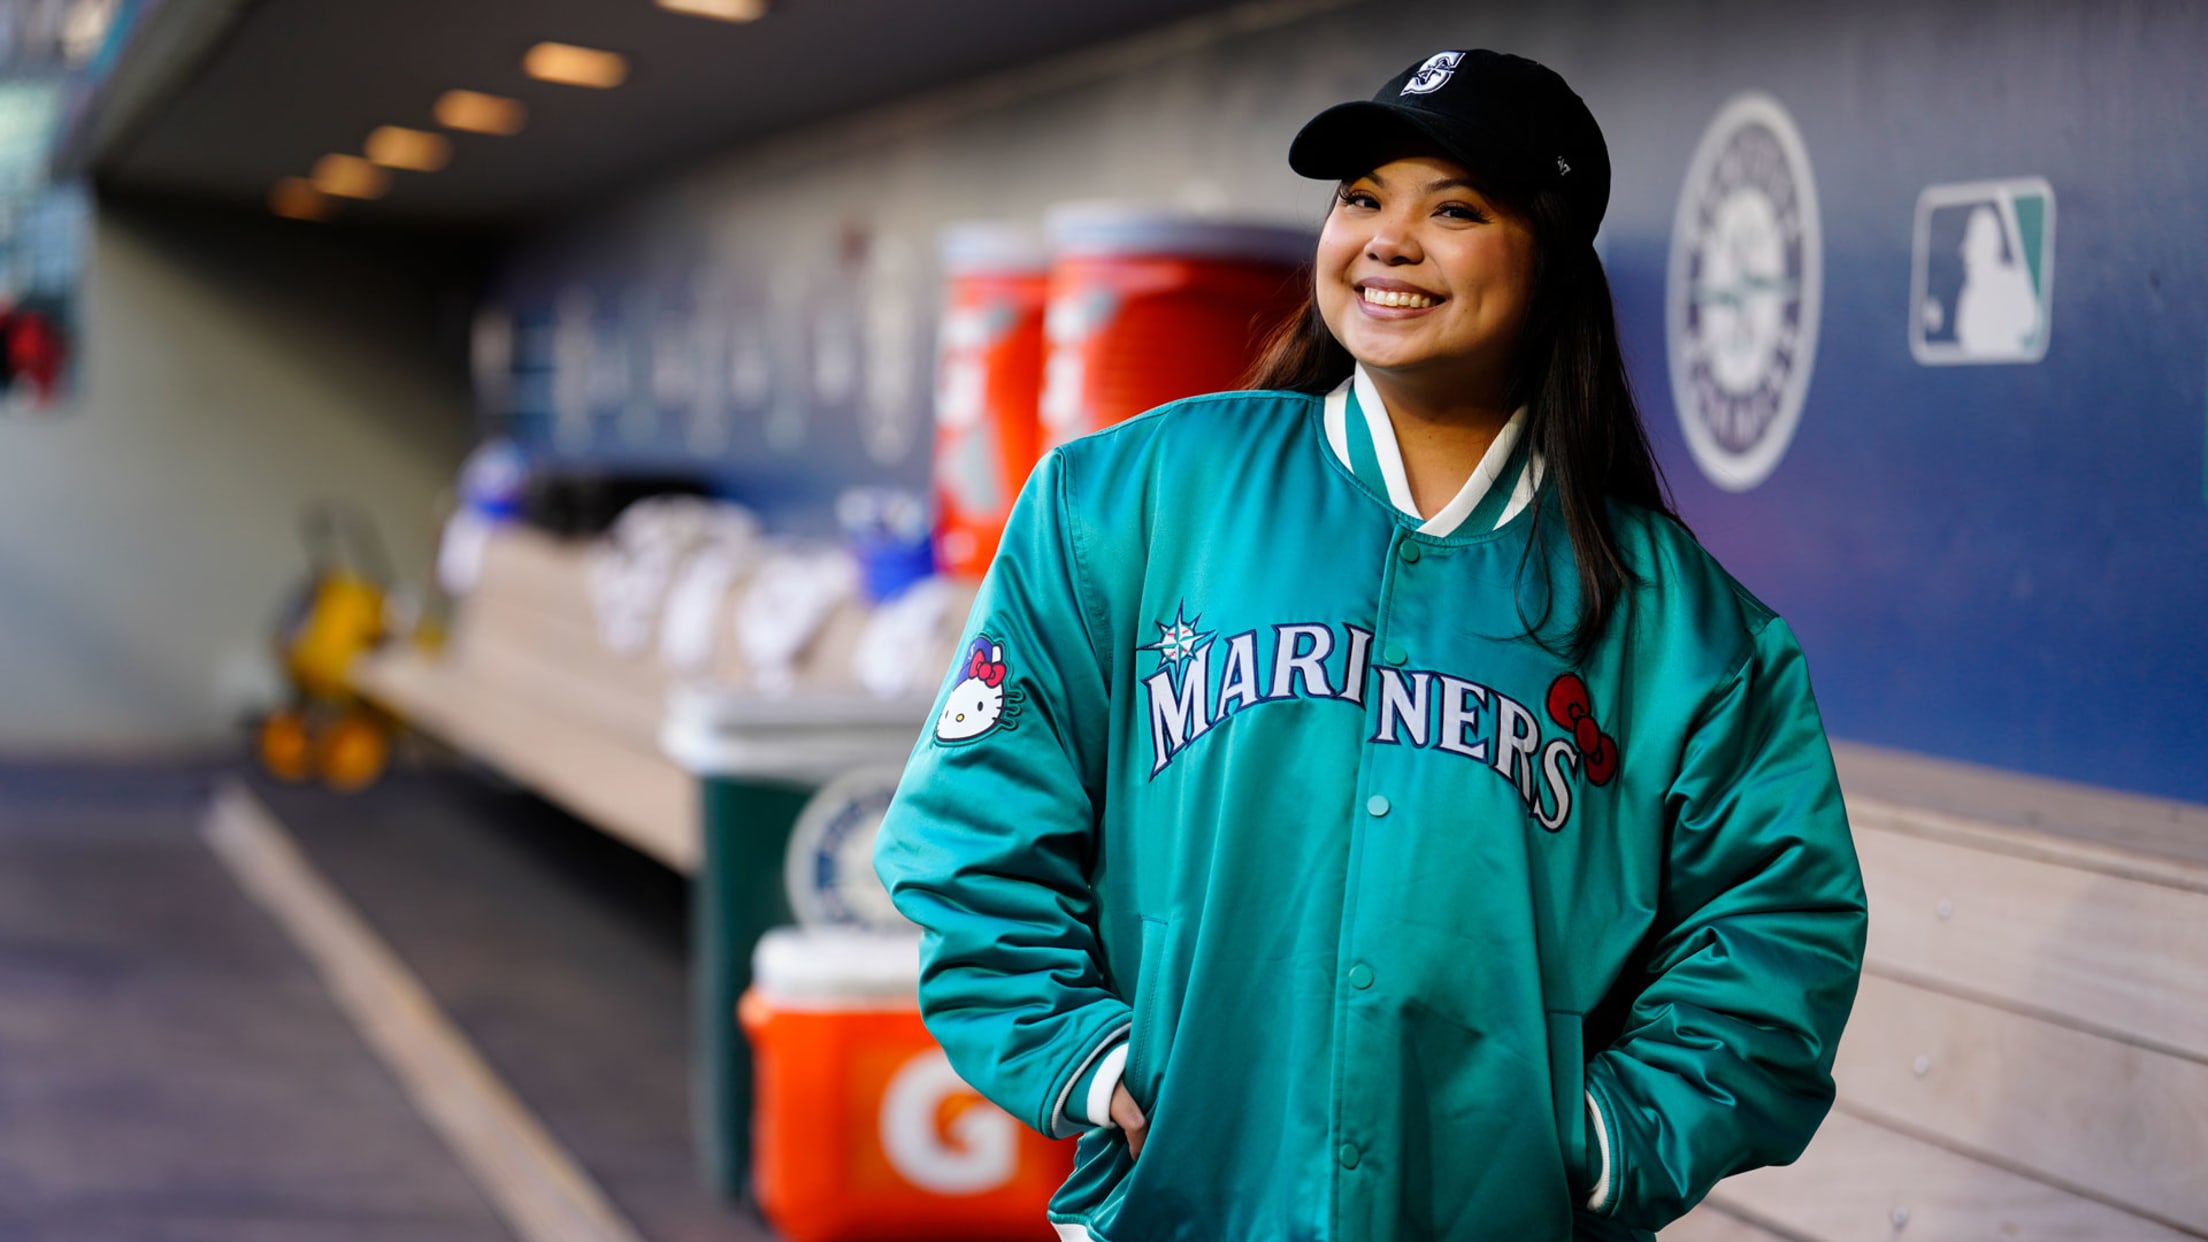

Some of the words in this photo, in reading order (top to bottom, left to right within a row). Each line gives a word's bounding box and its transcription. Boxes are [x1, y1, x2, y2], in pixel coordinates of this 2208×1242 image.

[1400, 51, 1466, 96] S
[1140, 621, 1580, 834] MARINERS
[878, 1047, 1020, 1196] G
